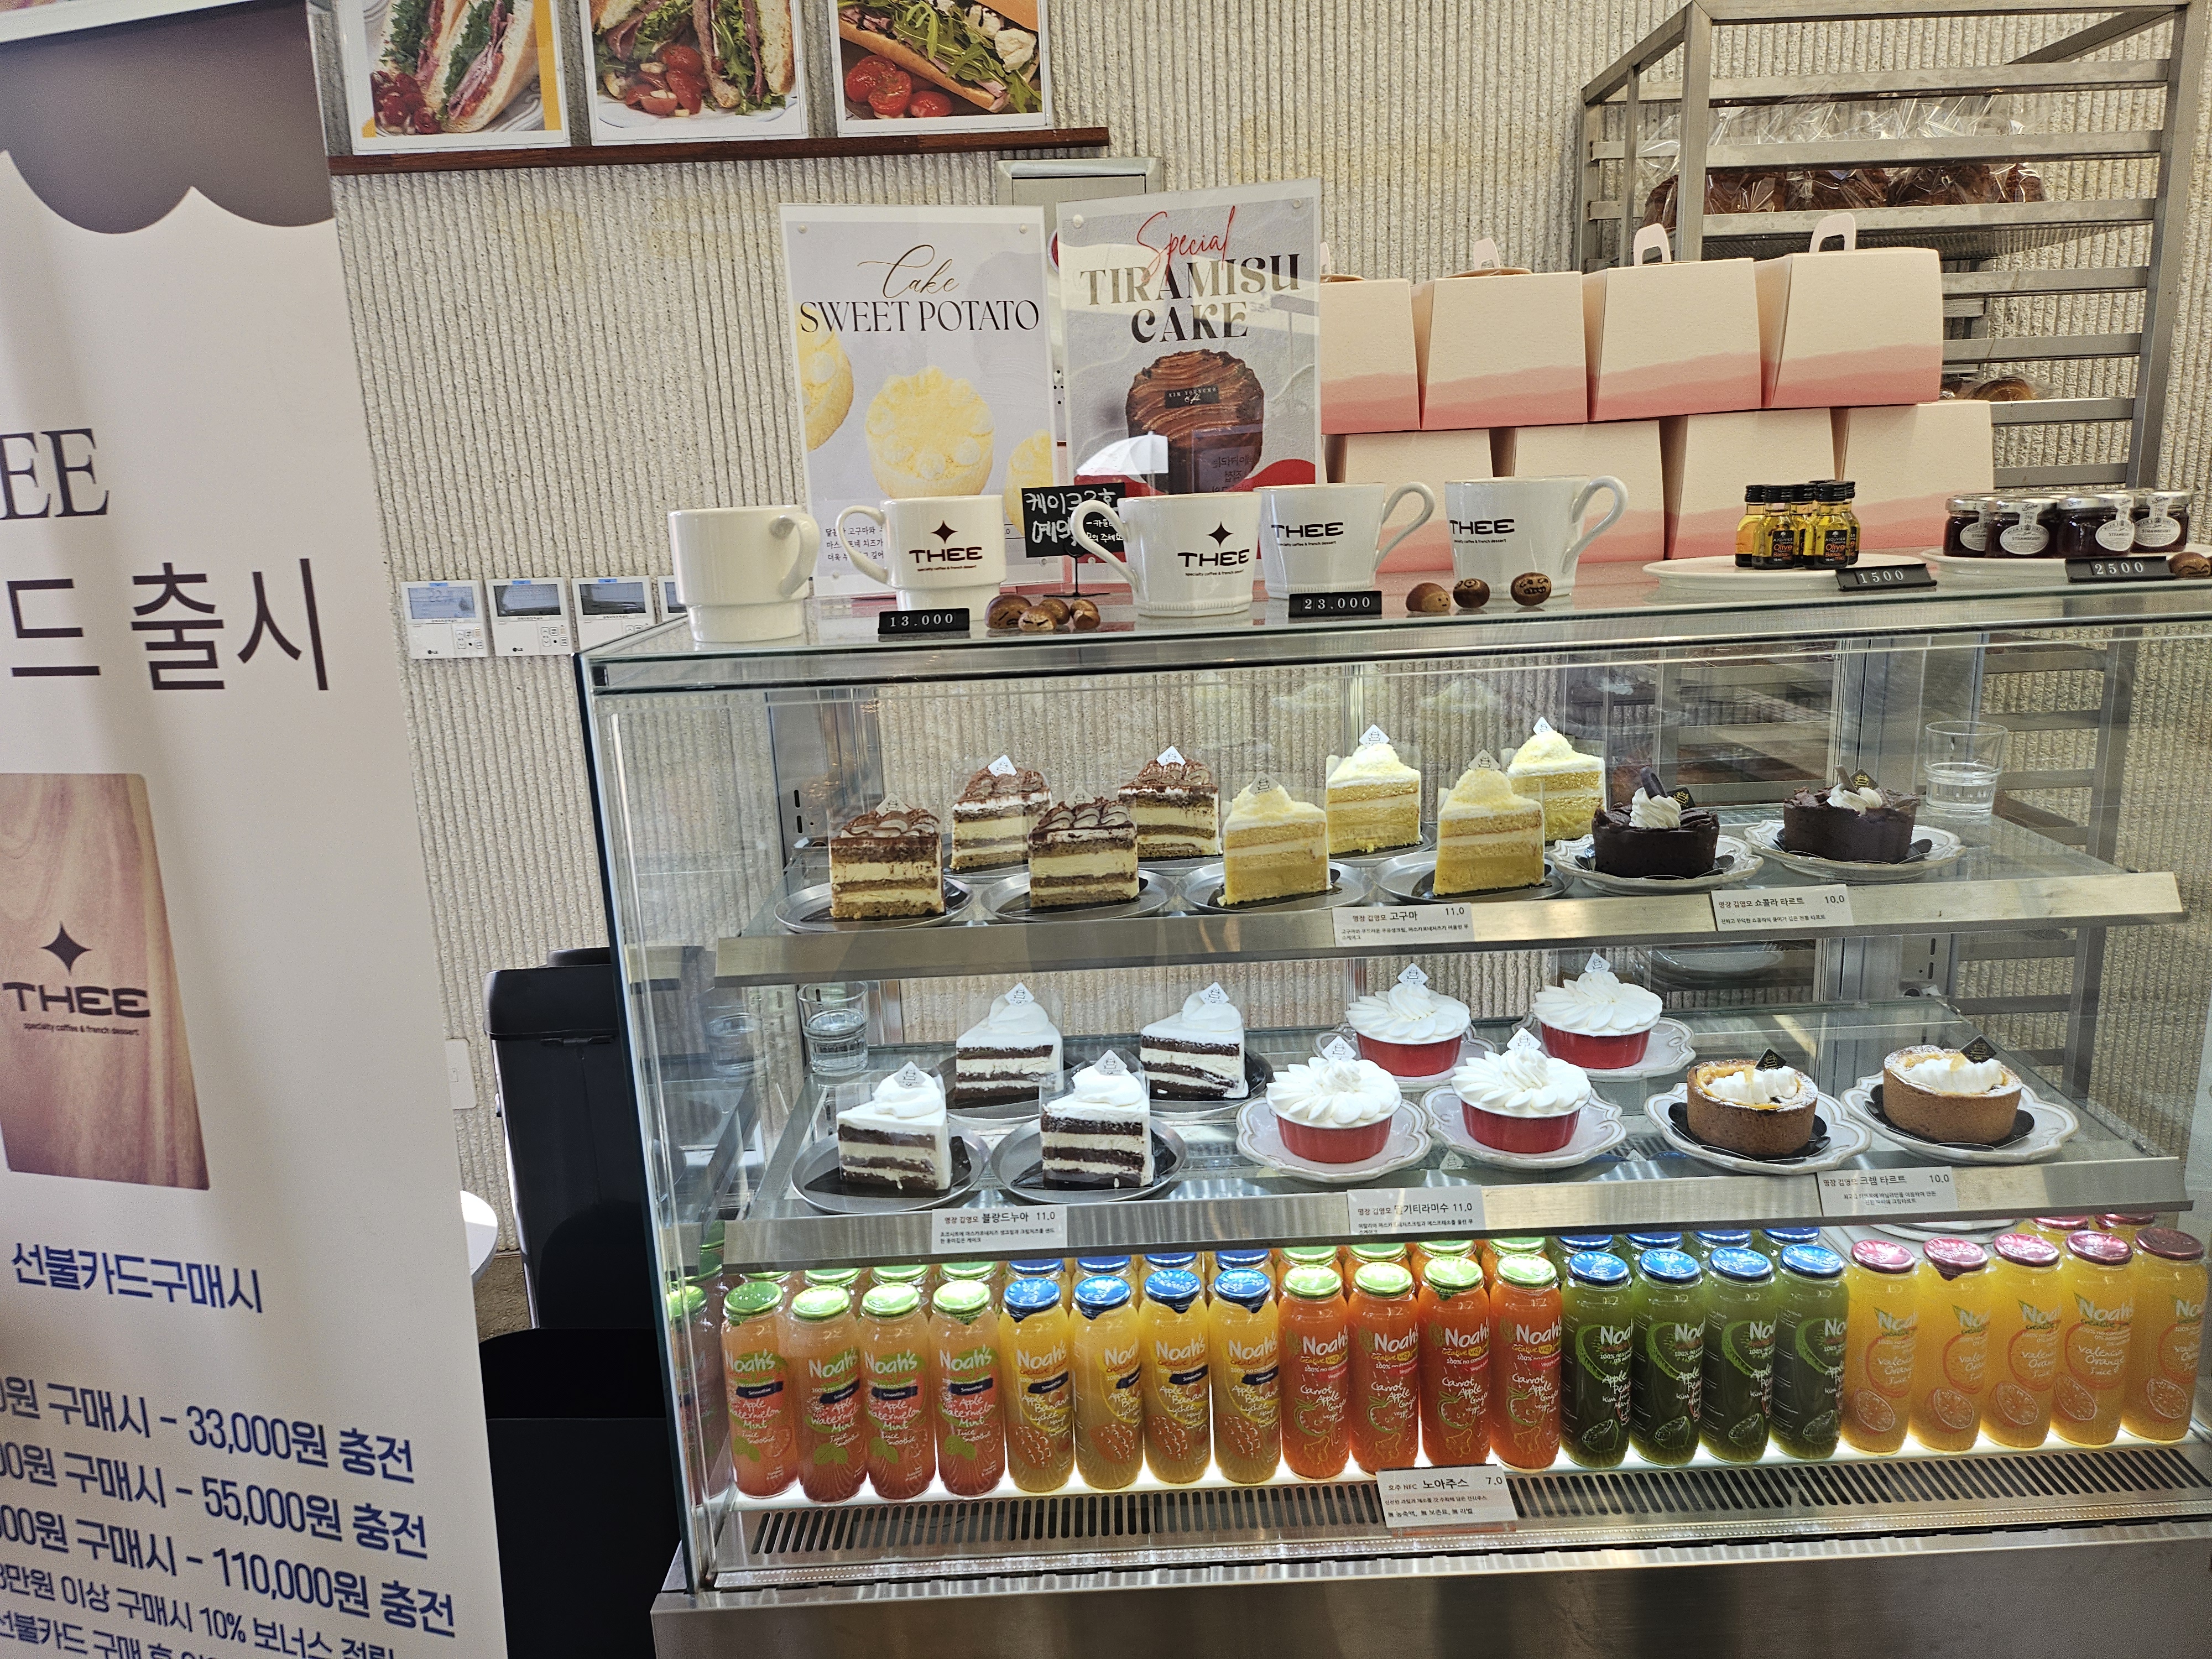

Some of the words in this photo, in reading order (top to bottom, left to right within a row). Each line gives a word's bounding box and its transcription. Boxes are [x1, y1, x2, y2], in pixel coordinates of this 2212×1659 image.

[1136, 205, 1236, 286] Special
[857, 244, 960, 299] Cake
[1080, 253, 1300, 305] TIRAMISU
[800, 301, 910, 332] SWEET
[919, 300, 1040, 332] POTATO
[1131, 301, 1248, 343] CAKE
[1271, 522, 1344, 538] THEE
[1449, 519, 1515, 535] THEE
[909, 546, 983, 564] THEE
[1177, 549, 1250, 567] THEE
[2094, 561, 2144, 575] 2500
[1859, 568, 1905, 584] 1500
[1303, 596, 1371, 610] 23.000
[7, 578, 101, 677] 드
[130, 558, 329, 691] 출시
[889, 613, 954, 628] 13.000
[1755, 898, 1778, 907] 쇼콜라
[1780, 897, 1805, 906] 타르트
[1824, 894, 1845, 904] 10.0
[1389, 911, 1418, 921] 고구마
[1444, 906, 1465, 915] 11.0
[2, 981, 151, 1019] THEE
[1860, 1176, 1877, 1186] 크렘
[1880, 1175, 1907, 1185] 타르트
[1929, 1173, 1949, 1183] 10.0
[1453, 1202, 1472, 1212] 11.0
[983, 1212, 1029, 1224] 블랑드누아
[1036, 1211, 1056, 1220] 11.0
[11, 1243, 264, 1314] 선불카드구매시
[724, 1348, 776, 1374] Noah's
[864, 1348, 918, 1374] Noah's
[940, 1344, 992, 1371] Noah's
[1442, 1376, 1475, 1387] Carrot
[1512, 1373, 1546, 1384] Carrot
[1601, 1369, 1627, 1388] Apple
[1159, 1384, 1183, 1398] Apple
[1231, 1384, 1256, 1397] Apple
[1300, 1384, 1332, 1395] Carrot
[1371, 1381, 1404, 1392] Carrot
[1457, 1383, 1483, 1399] Apple
[1527, 1380, 1553, 1396] Apple
[958, 1395, 984, 1410] Apple
[1021, 1394, 1045, 1406] Apple
[1316, 1390, 1340, 1406] Apple
[1386, 1387, 1411, 1404] Apple
[742, 1398, 766, 1412] Apple
[831, 1397, 853, 1413] Apple
[883, 1400, 907, 1413] Apple
[1167, 1403, 1196, 1417] Lychee
[1240, 1402, 1269, 1416] Lychee
[743, 1420, 768, 1430] Mint
[883, 1421, 909, 1430] Mint
[958, 1417, 984, 1427] Mint
[1030, 1411, 1057, 1426] Lychee
[46, 1383, 151, 1438] 구매시
[186, 1405, 330, 1467] 33,000원
[338, 1428, 415, 1484] 충전
[831, 1421, 855, 1433] Mint
[1423, 1478, 1469, 1489] 노아주스
[1485, 1476, 1503, 1485] 7.0
[64, 1451, 166, 1509] 구매시
[201, 1476, 343, 1542] 55,000원
[351, 1503, 429, 1559] 충전
[75, 1519, 177, 1576] 구매시
[213, 1548, 371, 1619] 110,000원
[380, 1579, 456, 1638] 충전
[61, 1575, 110, 1613] 이상
[117, 1587, 193, 1632] 구매시
[199, 1606, 247, 1644] 10%
[253, 1616, 333, 1659] 보너스
